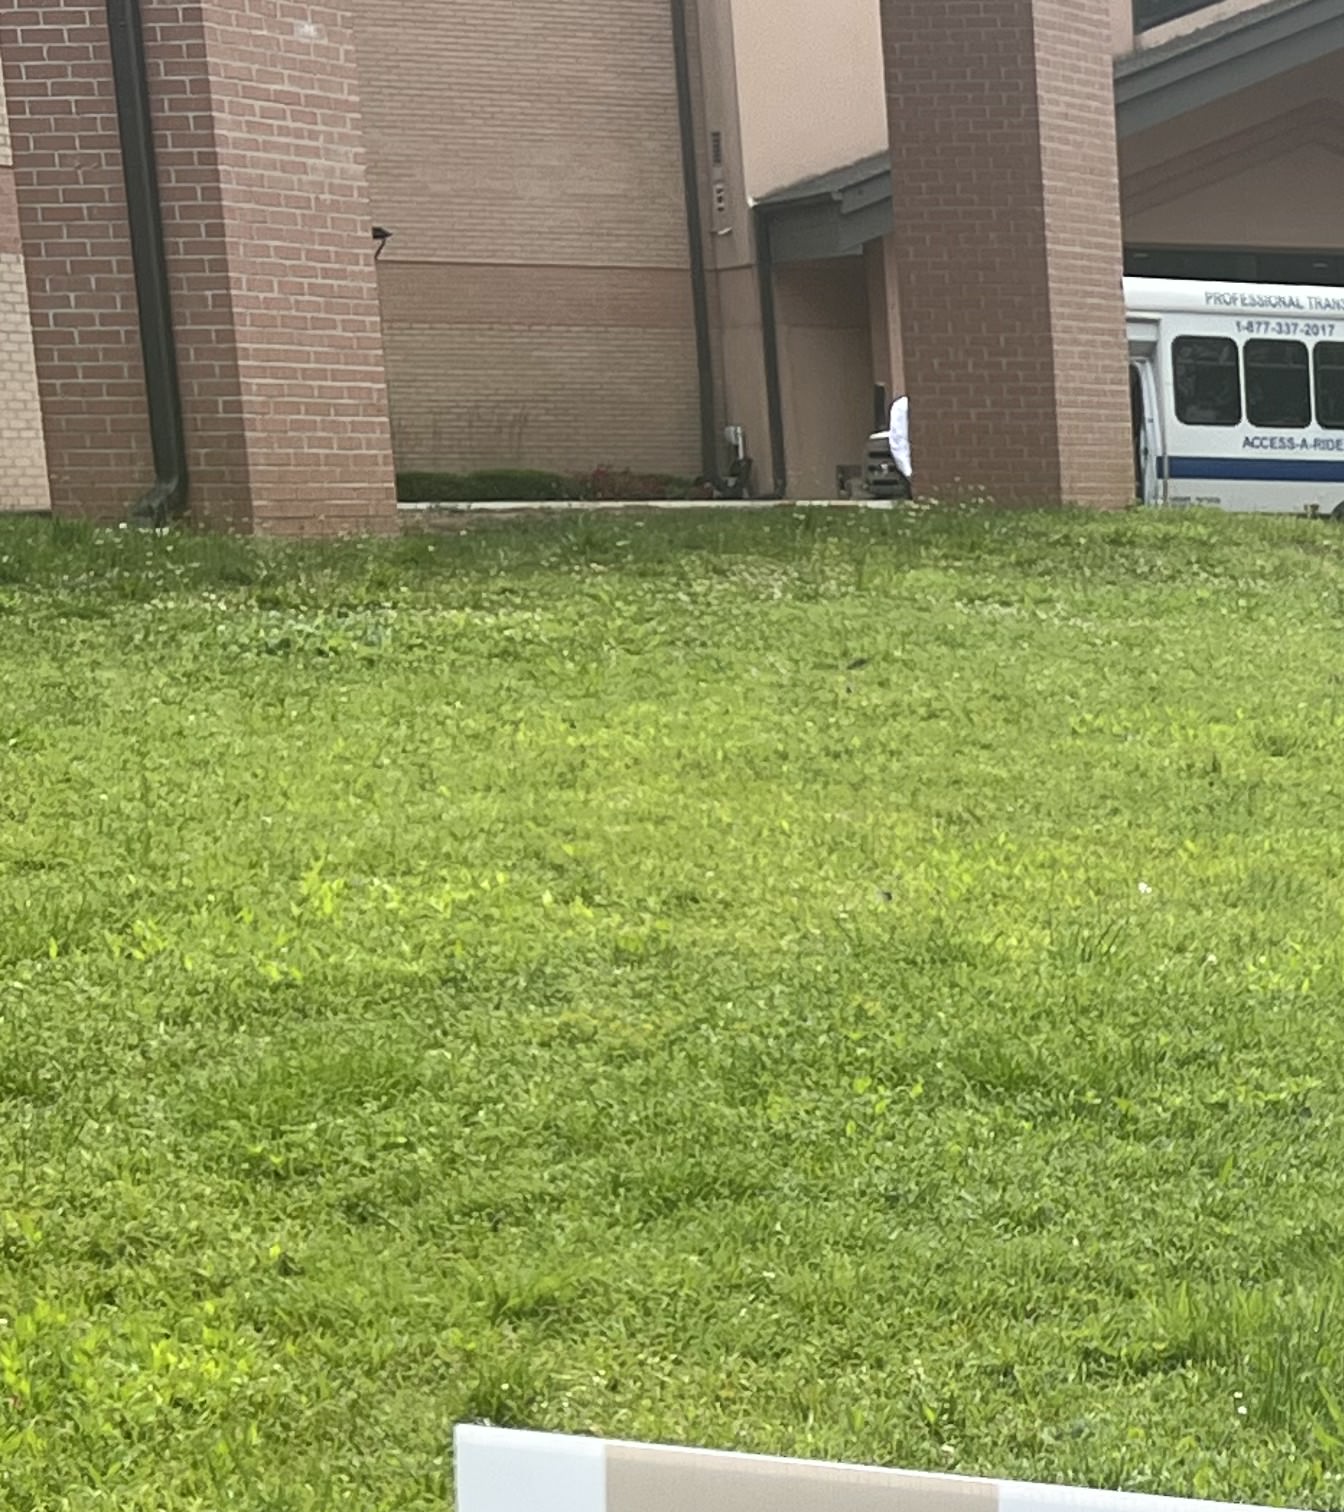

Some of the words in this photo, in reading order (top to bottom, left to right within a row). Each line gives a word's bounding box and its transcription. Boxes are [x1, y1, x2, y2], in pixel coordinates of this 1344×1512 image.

[1204, 291, 1304, 311] PROFESSIONAL
[1235, 320, 1336, 337] 1-877-337-2017
[1242, 435, 1344, 451] ACCESS-A-RIDE
